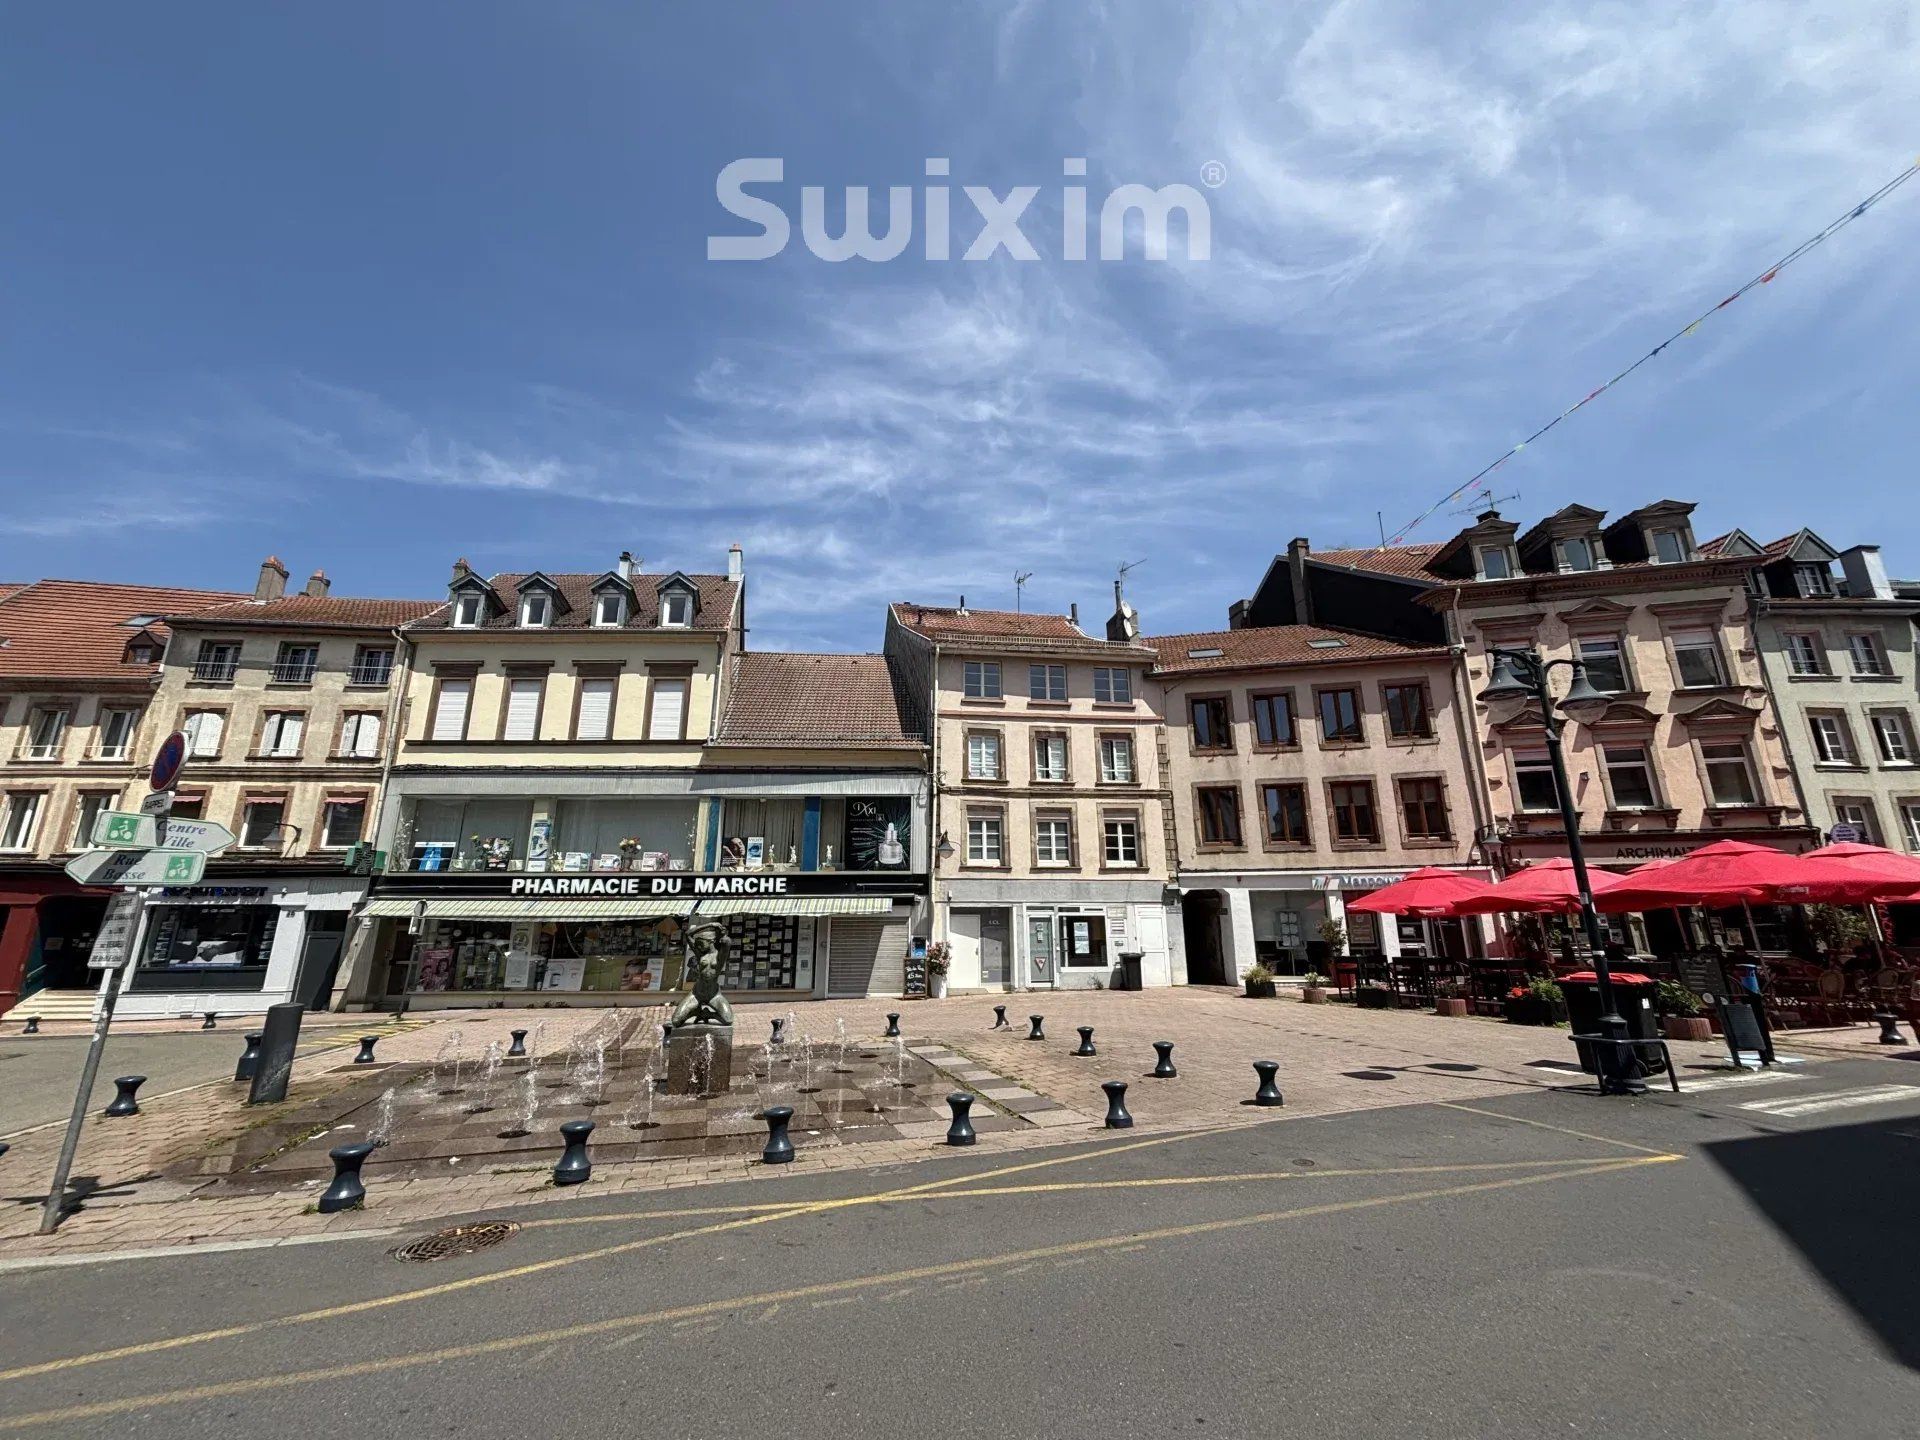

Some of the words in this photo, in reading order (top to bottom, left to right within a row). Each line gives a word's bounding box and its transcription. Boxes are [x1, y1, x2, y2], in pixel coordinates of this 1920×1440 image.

[157, 821, 207, 835] Centre
[164, 836, 195, 848] Ville
[114, 855, 140, 866] Rue
[102, 869, 146, 880] Basse
[511, 878, 640, 895] PHARMACIE
[651, 878, 682, 894] DU
[694, 877, 787, 894] MARCHE
